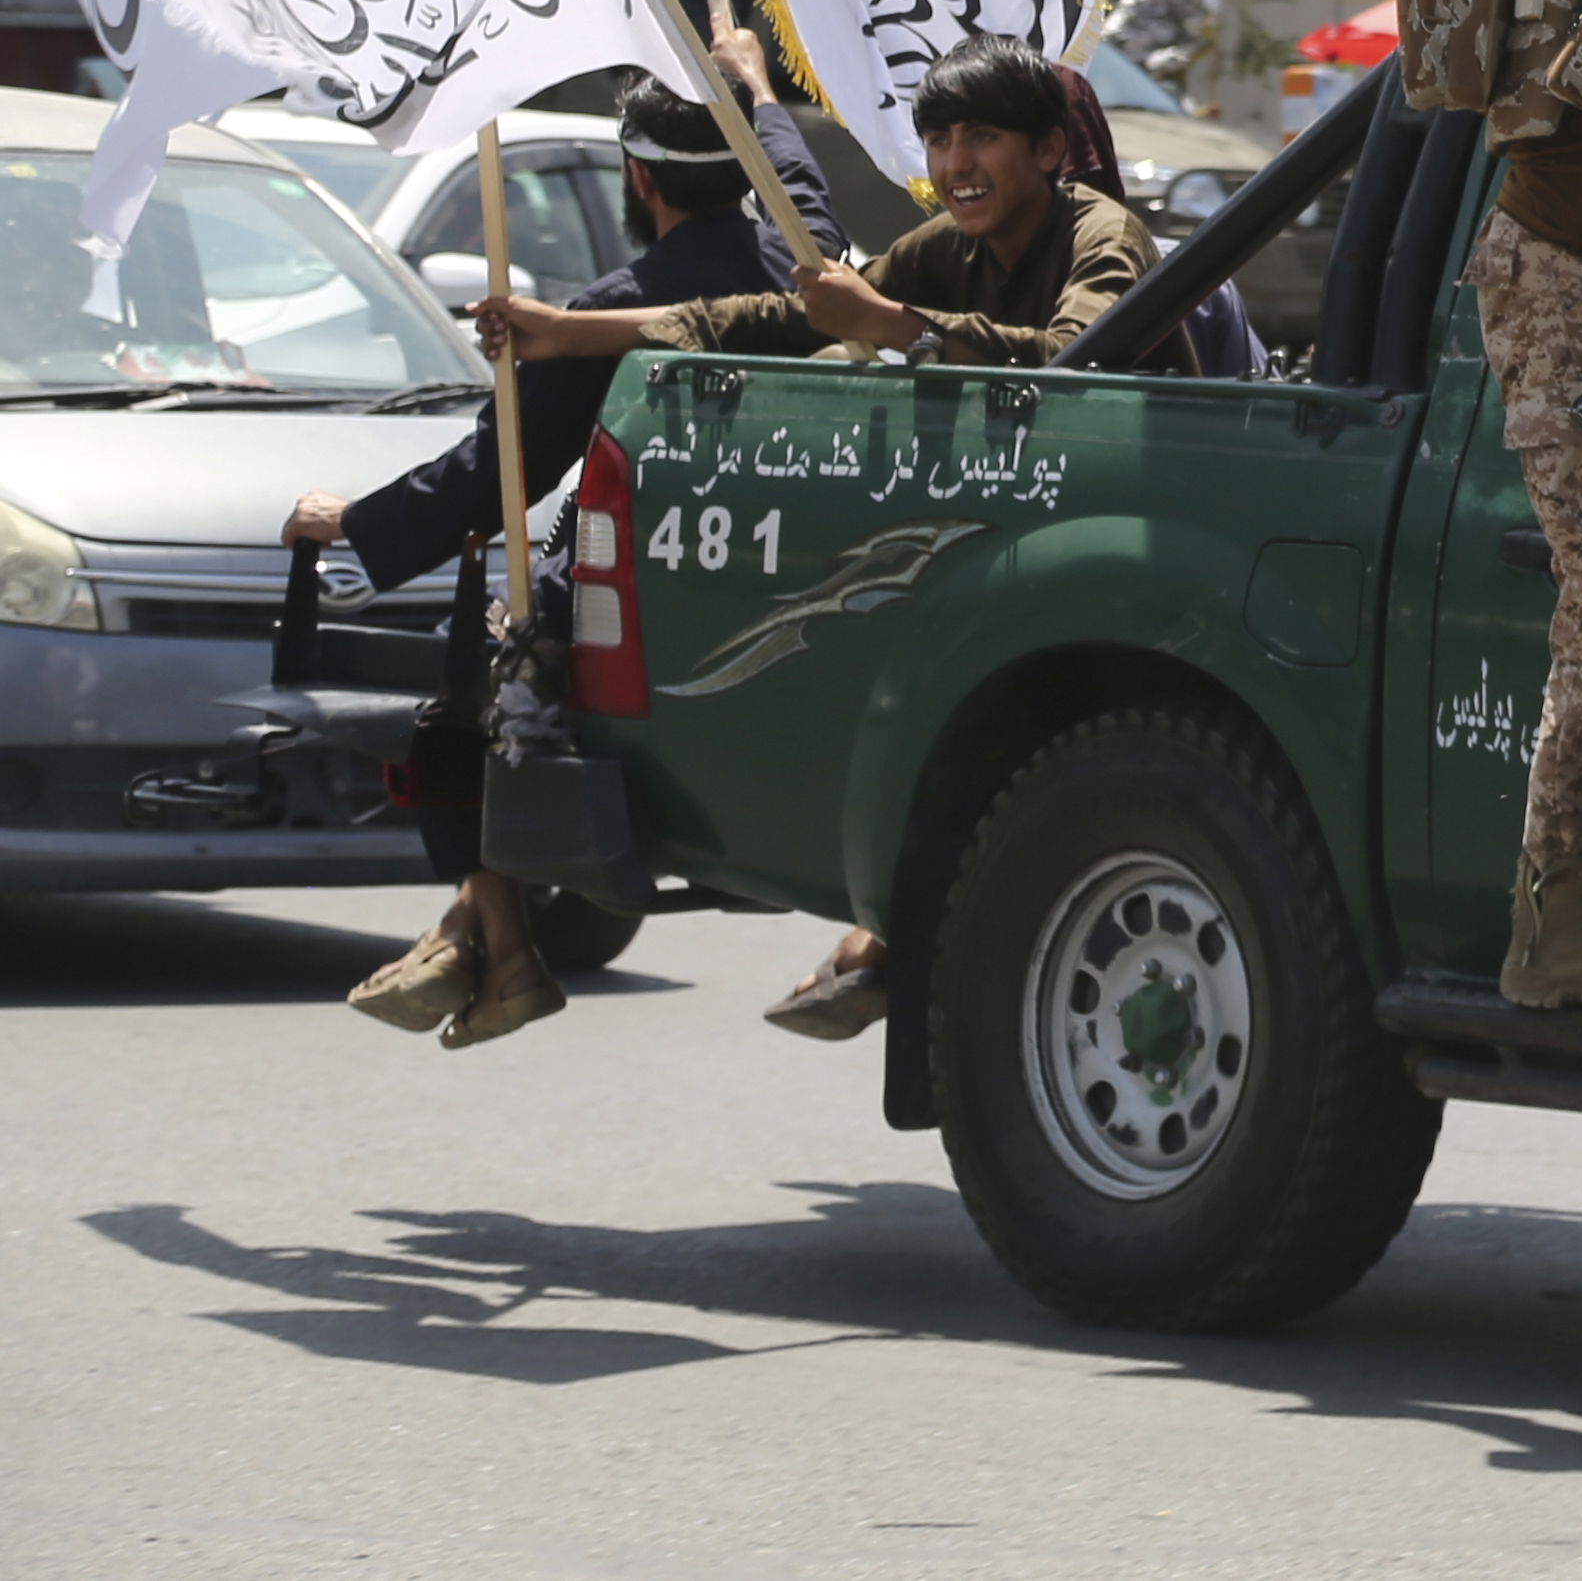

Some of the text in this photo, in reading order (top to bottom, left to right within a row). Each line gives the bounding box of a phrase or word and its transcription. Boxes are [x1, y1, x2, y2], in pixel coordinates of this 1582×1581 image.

[927, 423, 1067, 510] پولیس
[646, 504, 782, 575] 481
[1435, 656, 1514, 764] پولیس
